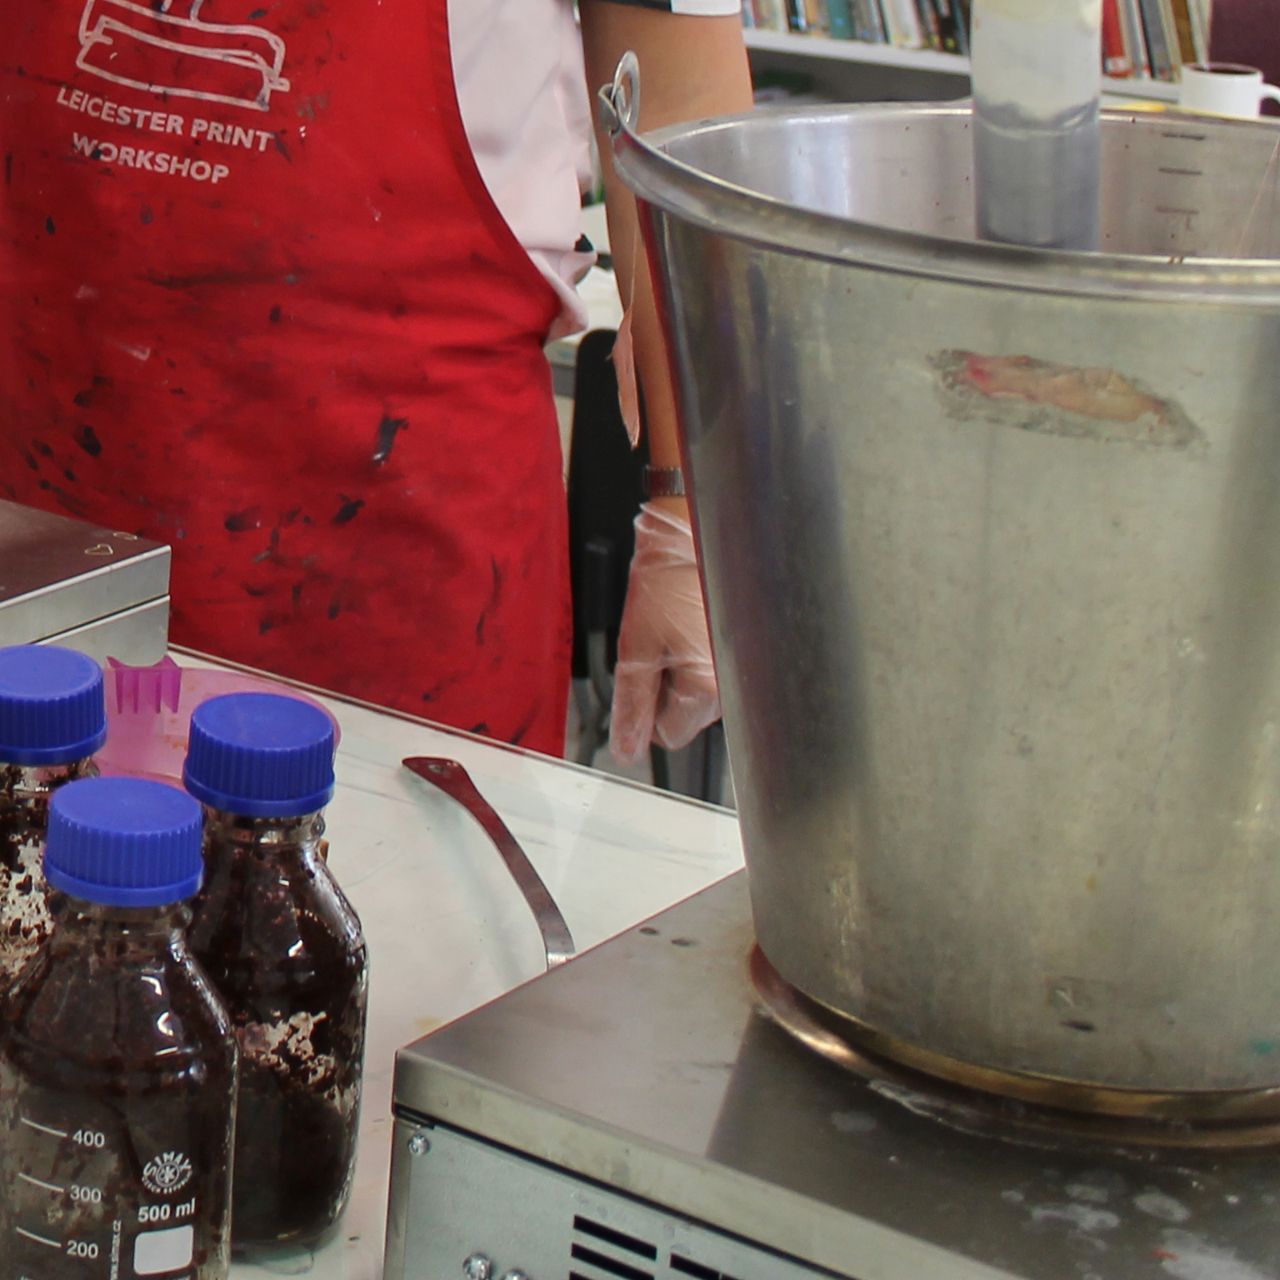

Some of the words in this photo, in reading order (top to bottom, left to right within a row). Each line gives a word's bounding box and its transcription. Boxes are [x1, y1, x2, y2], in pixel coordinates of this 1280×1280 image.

[56, 87, 184, 135] LEICESTER
[191, 118, 273, 152] PRINT
[72, 131, 230, 184] WORKSHOP
[72, 1130, 106, 1148] 400
[70, 1184, 102, 1203] 300
[137, 1203, 171, 1223] 500
[175, 1197, 196, 1218] ml
[66, 1239, 99, 1259] 200
